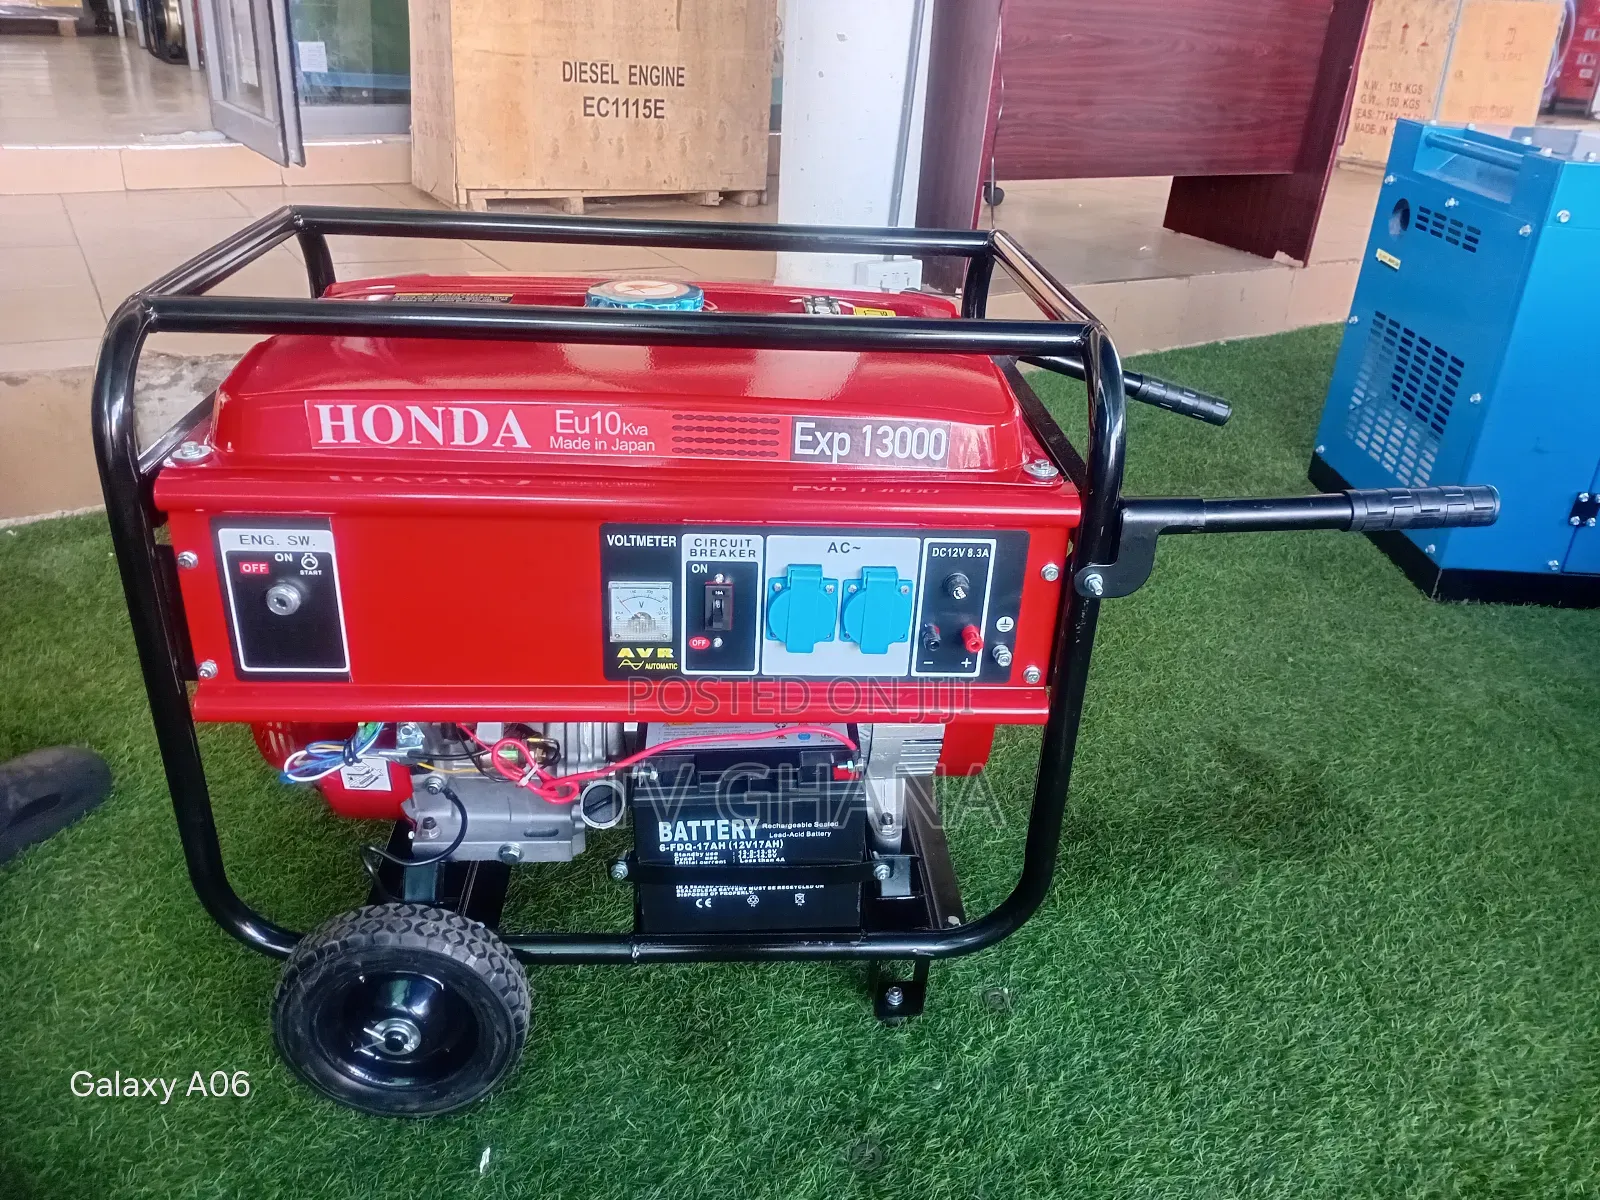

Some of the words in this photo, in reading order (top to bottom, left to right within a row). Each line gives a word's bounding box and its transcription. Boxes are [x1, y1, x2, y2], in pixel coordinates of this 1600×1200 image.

[562, 61, 620, 85] DIESEL
[628, 64, 686, 87] ENGINE
[1405, 83, 1423, 95] KGS
[583, 96, 665, 119] EC1115E
[1386, 96, 1400, 108] 150
[1403, 98, 1420, 110] KGS
[1354, 122, 1376, 135] MADE
[1380, 126, 1388, 136] IN
[314, 404, 532, 449] HONDA
[549, 435, 590, 452] Made
[595, 437, 607, 451] in
[611, 439, 655, 458] Japan
[793, 420, 851, 464] Exp
[862, 424, 947, 462] 13000
[239, 534, 280, 546] ENG.
[287, 535, 316, 547] SW.
[607, 534, 677, 548] VOLTMETER
[694, 538, 752, 548] CIRCUIT
[274, 552, 293, 562] ON
[690, 548, 756, 558] BREAKER
[931, 547, 966, 558] DC12V
[967, 548, 990, 558] 8.3A
[242, 563, 267, 573] OFF
[691, 563, 708, 574] ON
[692, 639, 706, 647] OFF
[617, 647, 675, 659] AVR
[645, 662, 678, 671] AUTOMATIC
[658, 818, 761, 843] BATTERY
[761, 822, 812, 830] Rechargeable
[806, 830, 831, 838] Battery
[659, 841, 726, 853] 6-FDQ-17AH
[728, 839, 785, 851] (12V17AH)
